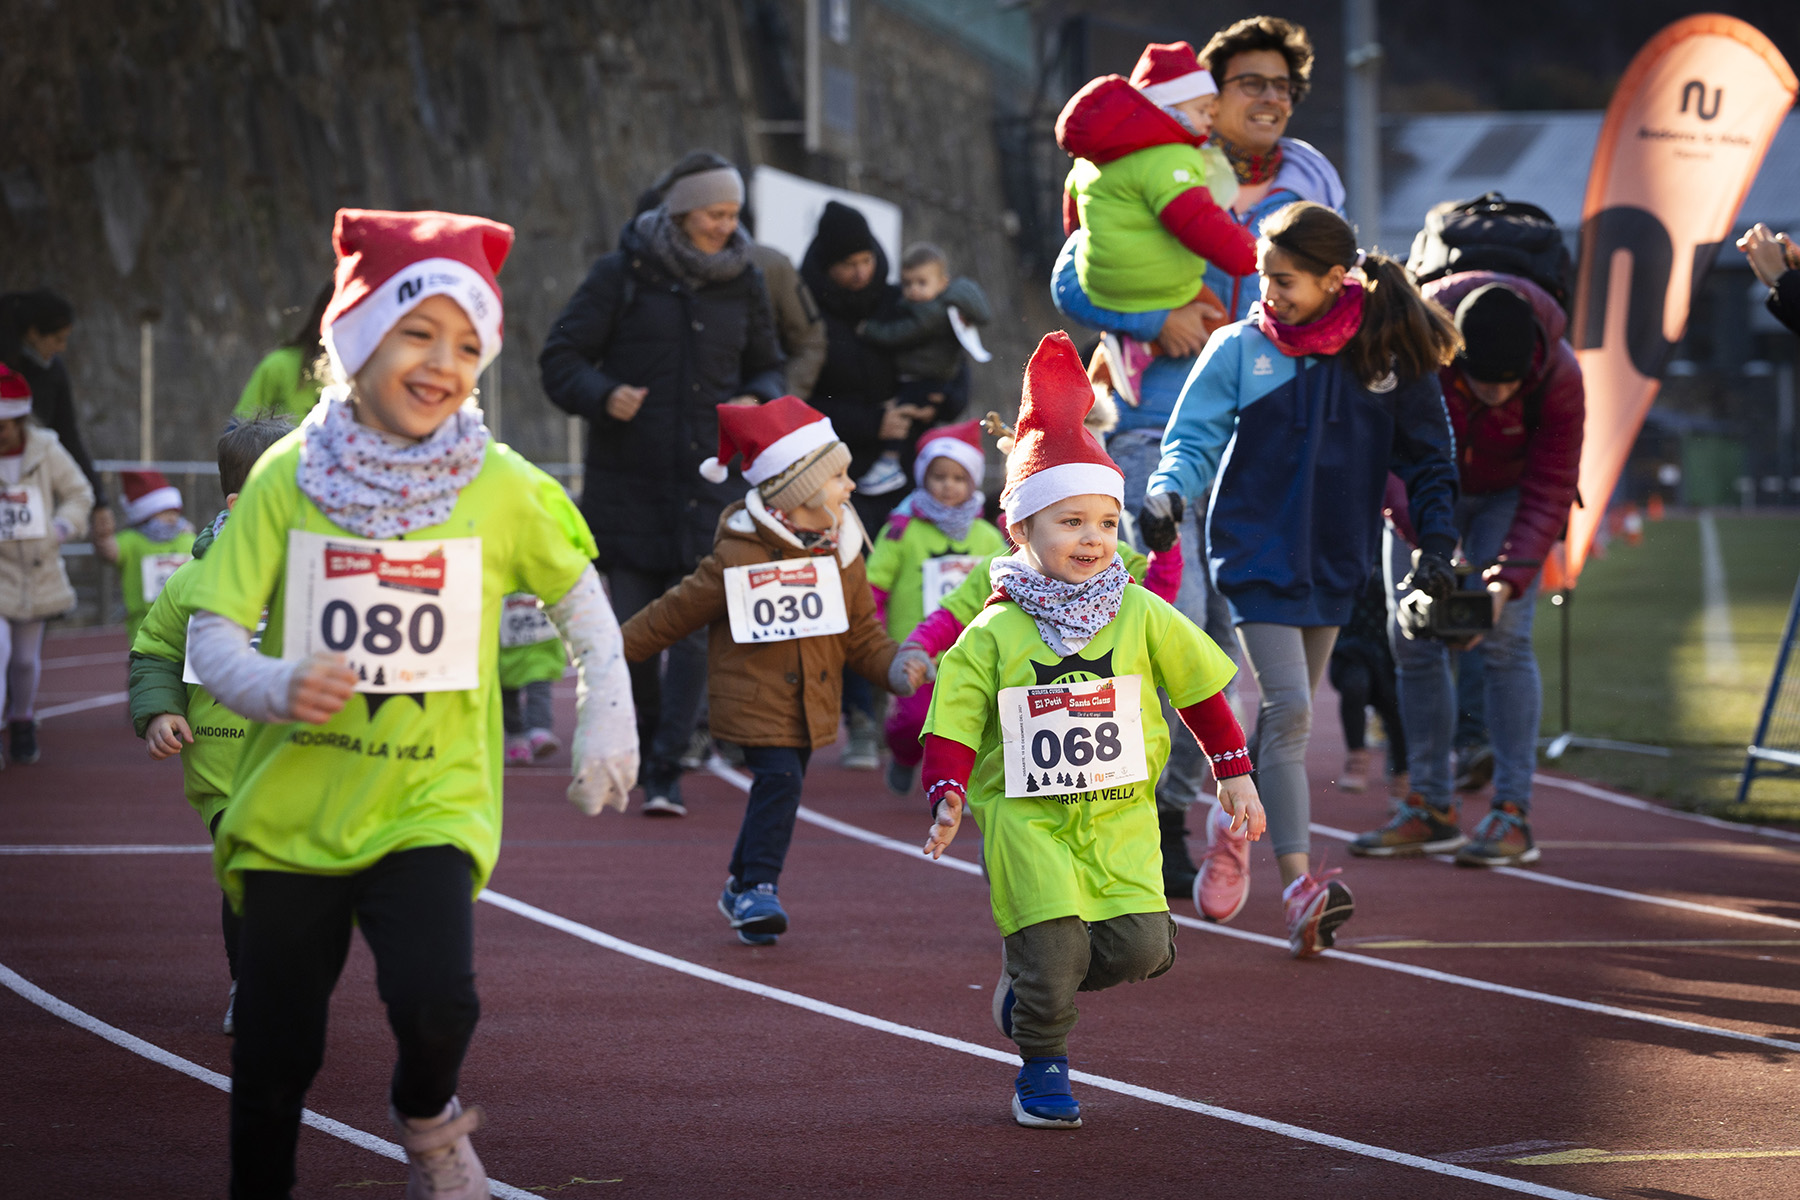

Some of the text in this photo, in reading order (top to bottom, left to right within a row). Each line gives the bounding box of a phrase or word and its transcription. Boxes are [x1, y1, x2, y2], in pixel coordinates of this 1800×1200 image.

[753, 592, 823, 626] 030
[321, 599, 445, 655] 080
[1034, 696, 1063, 709] El Petit
[1069, 696, 1111, 708] Santa Claus
[195, 726, 245, 739] ANDORRA
[367, 742, 388, 758] LA
[1031, 721, 1122, 769] 068
[1085, 790, 1098, 802] LA
[1101, 787, 1135, 801] VELLA
